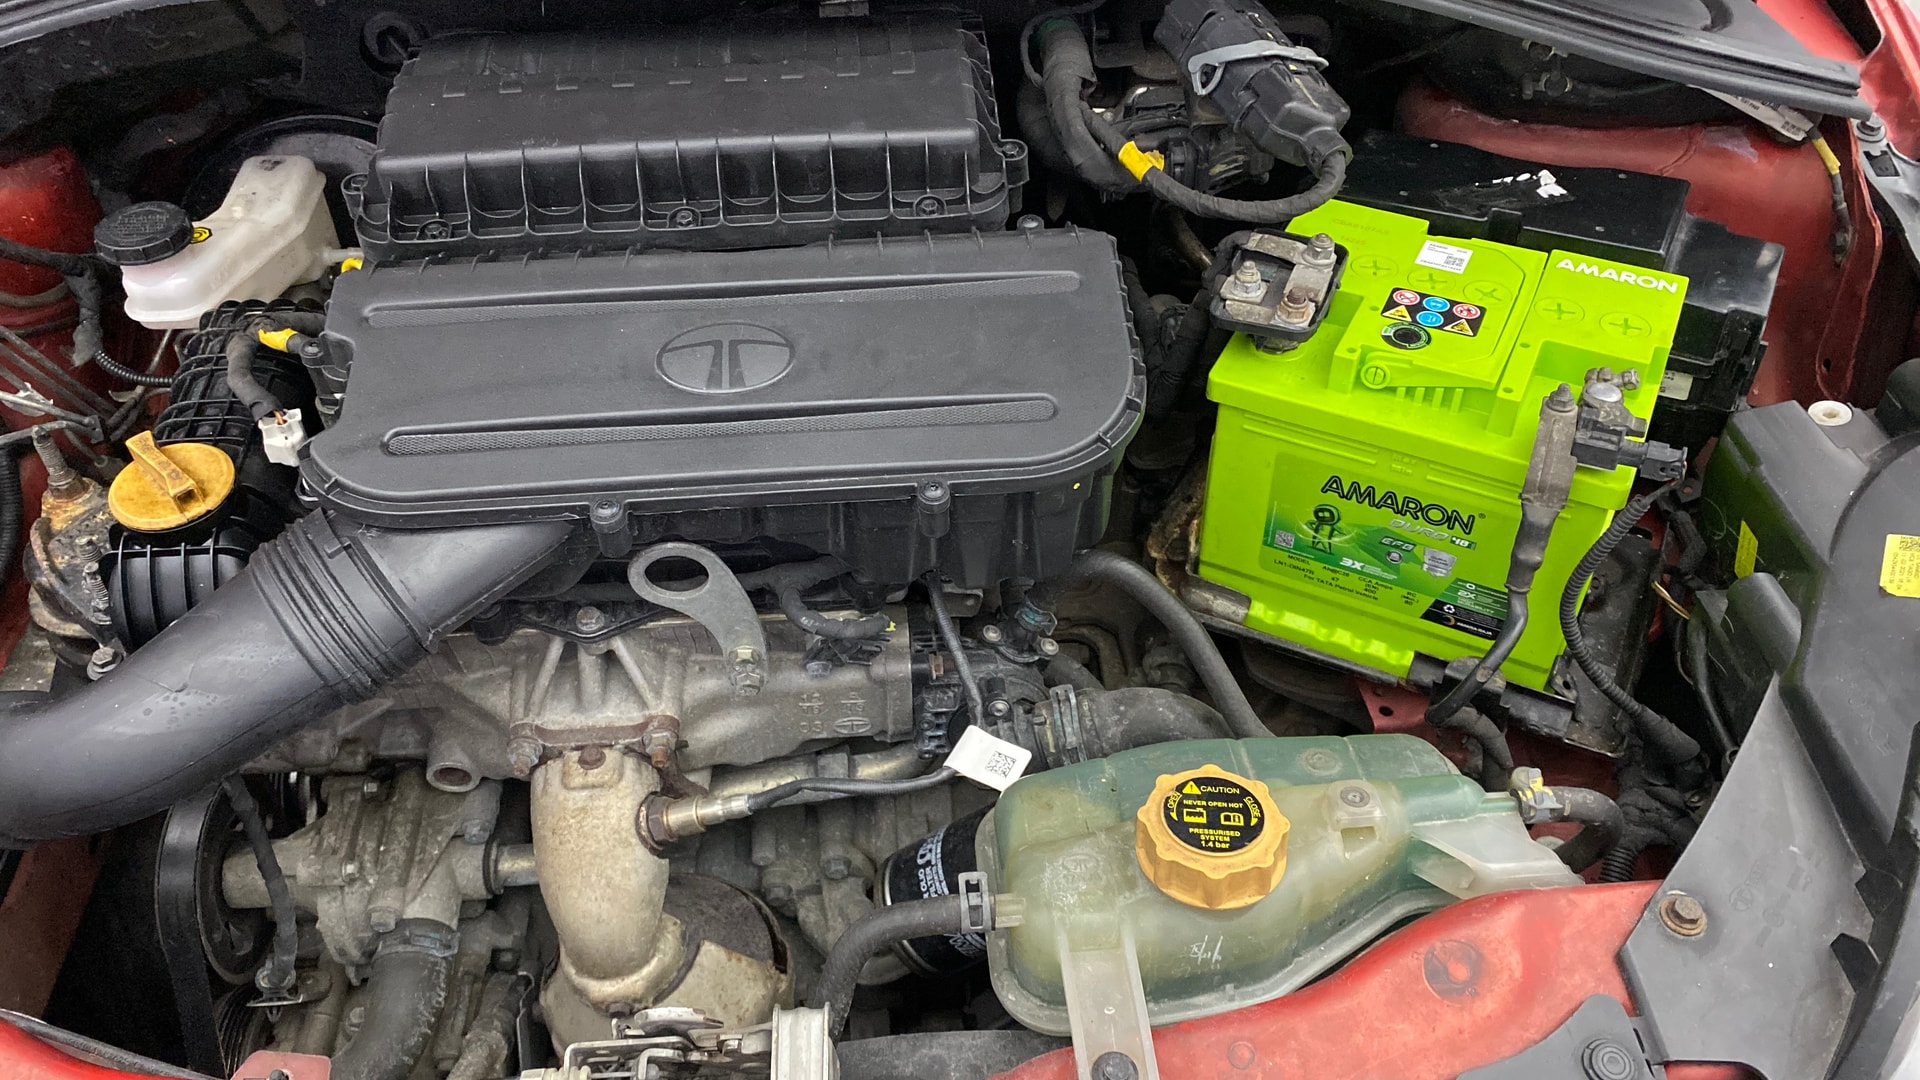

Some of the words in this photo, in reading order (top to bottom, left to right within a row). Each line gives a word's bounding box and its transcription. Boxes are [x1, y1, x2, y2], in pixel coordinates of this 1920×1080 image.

[1555, 259, 1678, 294] AMARON
[1320, 475, 1475, 535] AMARON
[1389, 518, 1450, 541] DURO
[1287, 554, 1311, 565] MODEL
[1340, 557, 1364, 570] 3X
[1317, 578, 1333, 587] TATA
[1358, 576, 1373, 585] CCA
[1200, 785, 1240, 795] CAUTION
[1167, 791, 1182, 809] OPEN
[1183, 799, 1207, 807] NEVER
[1207, 800, 1227, 808] OPEN
[1228, 801, 1244, 809] HOT
[1245, 796, 1261, 818] CLOSE
[1189, 827, 1241, 837] PRESSURISED
[1200, 834, 1230, 842] SYSTEM
[1201, 840, 1214, 848] 1.4
[1215, 841, 1230, 849] bar
